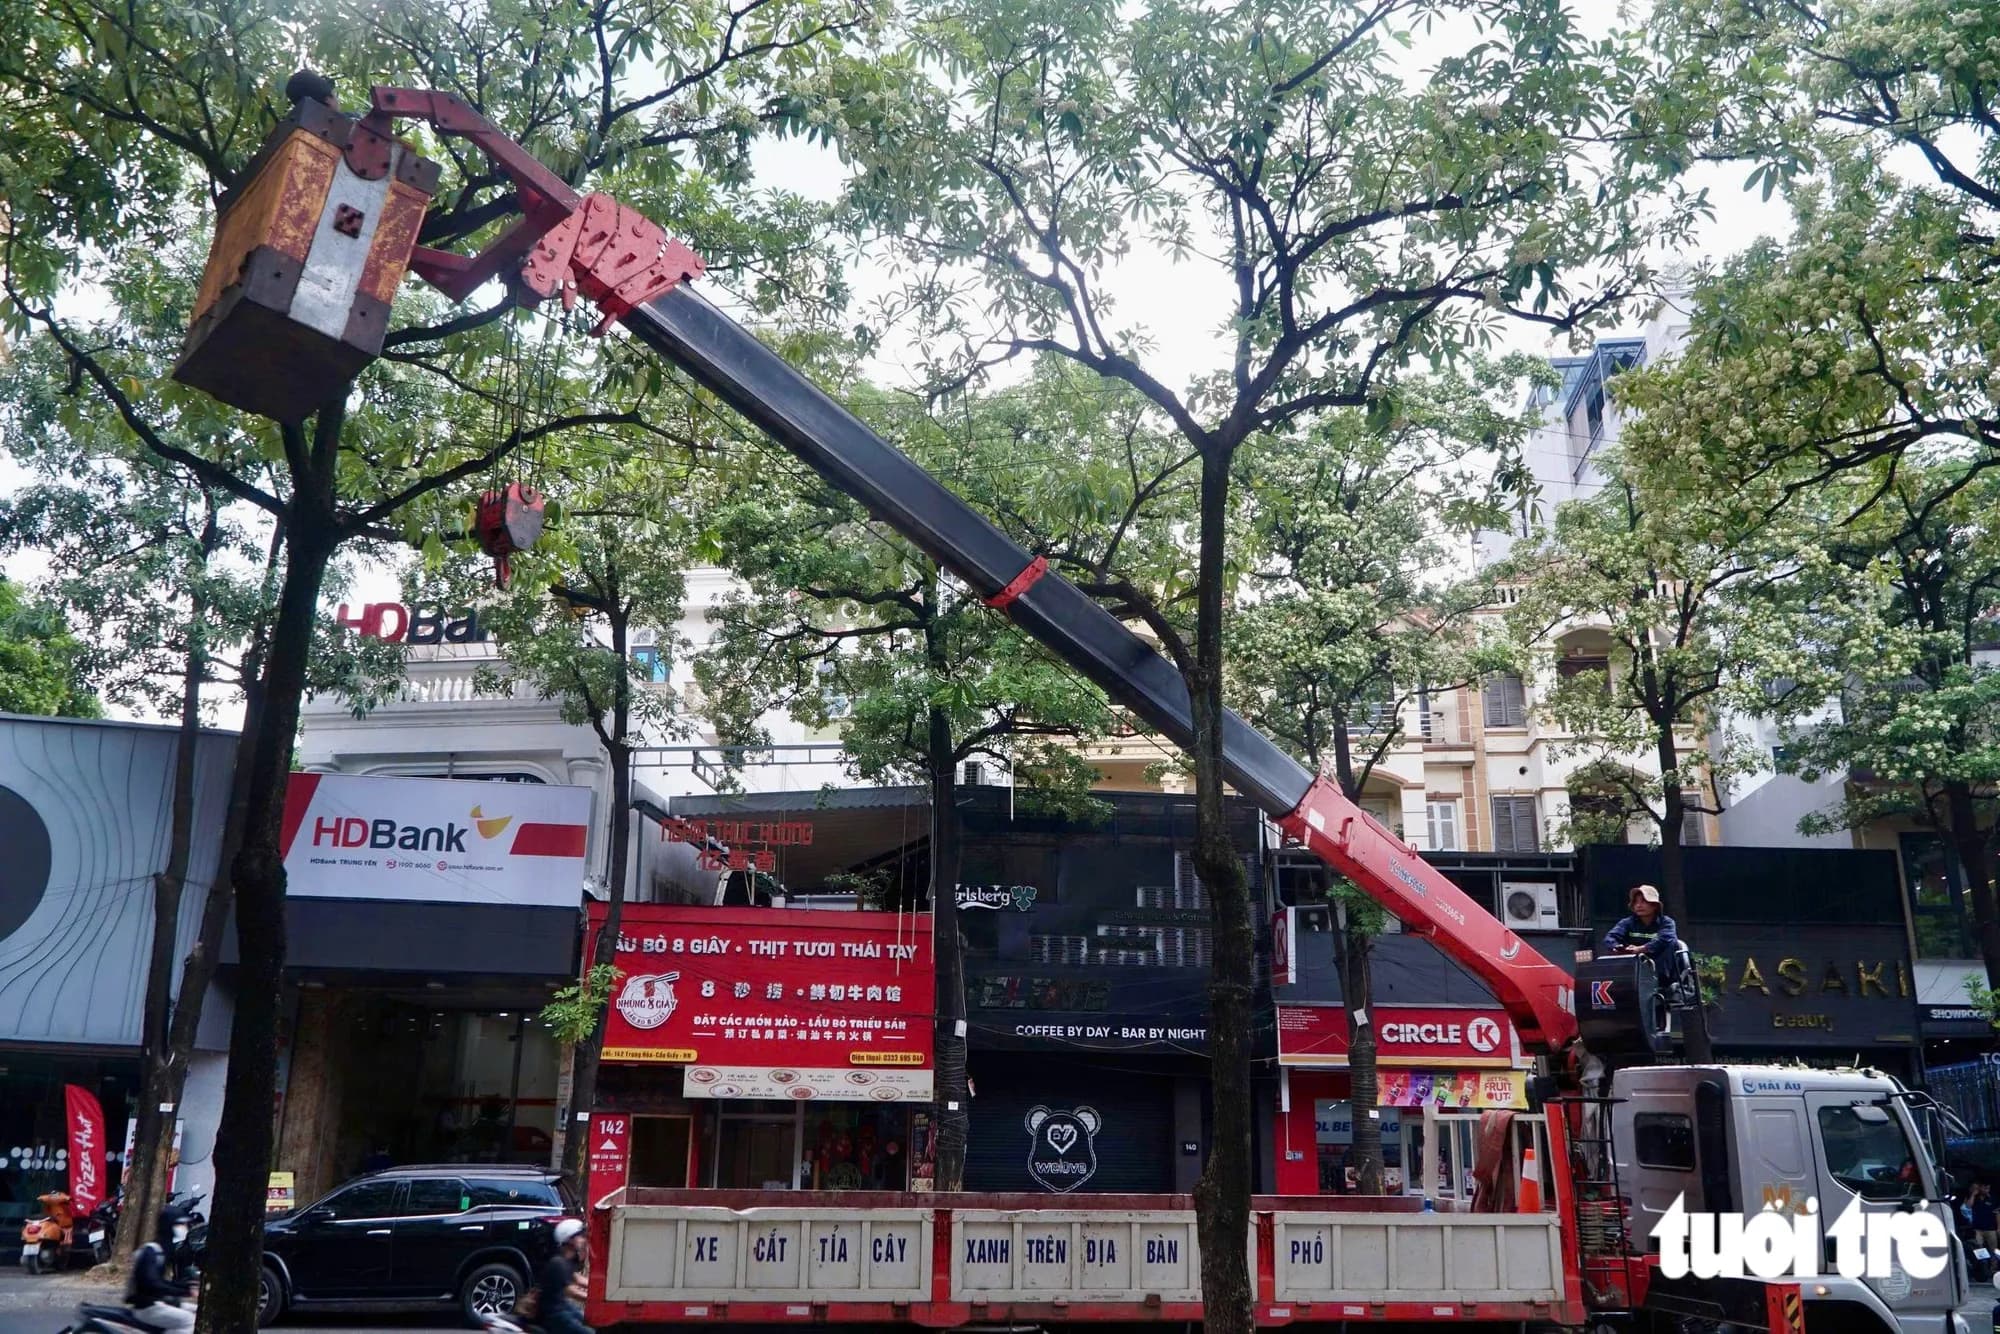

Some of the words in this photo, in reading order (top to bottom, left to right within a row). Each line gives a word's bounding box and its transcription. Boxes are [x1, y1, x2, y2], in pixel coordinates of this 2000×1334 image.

[313, 816, 468, 853] HDBank
[643, 934, 667, 953] BÒ
[672, 938, 684, 953] 8
[690, 935, 731, 954] GIÂY
[749, 940, 788, 959] THỊT
[793, 941, 835, 957] TƯƠI
[841, 940, 880, 958] THÁI
[886, 944, 917, 959] TAY
[701, 980, 715, 997] 8
[1592, 981, 1615, 1005] K
[693, 1014, 716, 1028] ĐẶT
[719, 1013, 742, 1026] CÁC
[744, 1013, 772, 1027] MÓN
[774, 1014, 797, 1027] XÀO
[832, 1016, 847, 1028] BÒ
[1016, 1025, 1064, 1037] COFFEE
[1067, 1026, 1084, 1037] BY
[1086, 1026, 1110, 1038] DAY
[1121, 1027, 1146, 1039] BAR
[1149, 1028, 1165, 1039] BY
[1168, 1028, 1206, 1041] NIGHT
[1381, 1023, 1462, 1044] CIRCLE
[1484, 1082, 1512, 1092] FRUIT
[74, 1111, 95, 1149] Hut
[600, 1120, 624, 1134] 142
[1185, 1143, 1197, 1151] 140
[75, 1151, 97, 1200] Pizza
[1035, 1159, 1087, 1174] welove
[695, 1236, 718, 1262] XE
[756, 1228, 787, 1263] CẮT
[820, 1224, 848, 1263] TỈA
[872, 1232, 907, 1263] CÂY
[966, 1238, 1010, 1264] XANH
[1027, 1234, 1066, 1264] TRÊN
[1086, 1238, 1117, 1267] ĐỊA
[1147, 1233, 1178, 1264] BÀN
[1290, 1230, 1323, 1264] PHỐ
